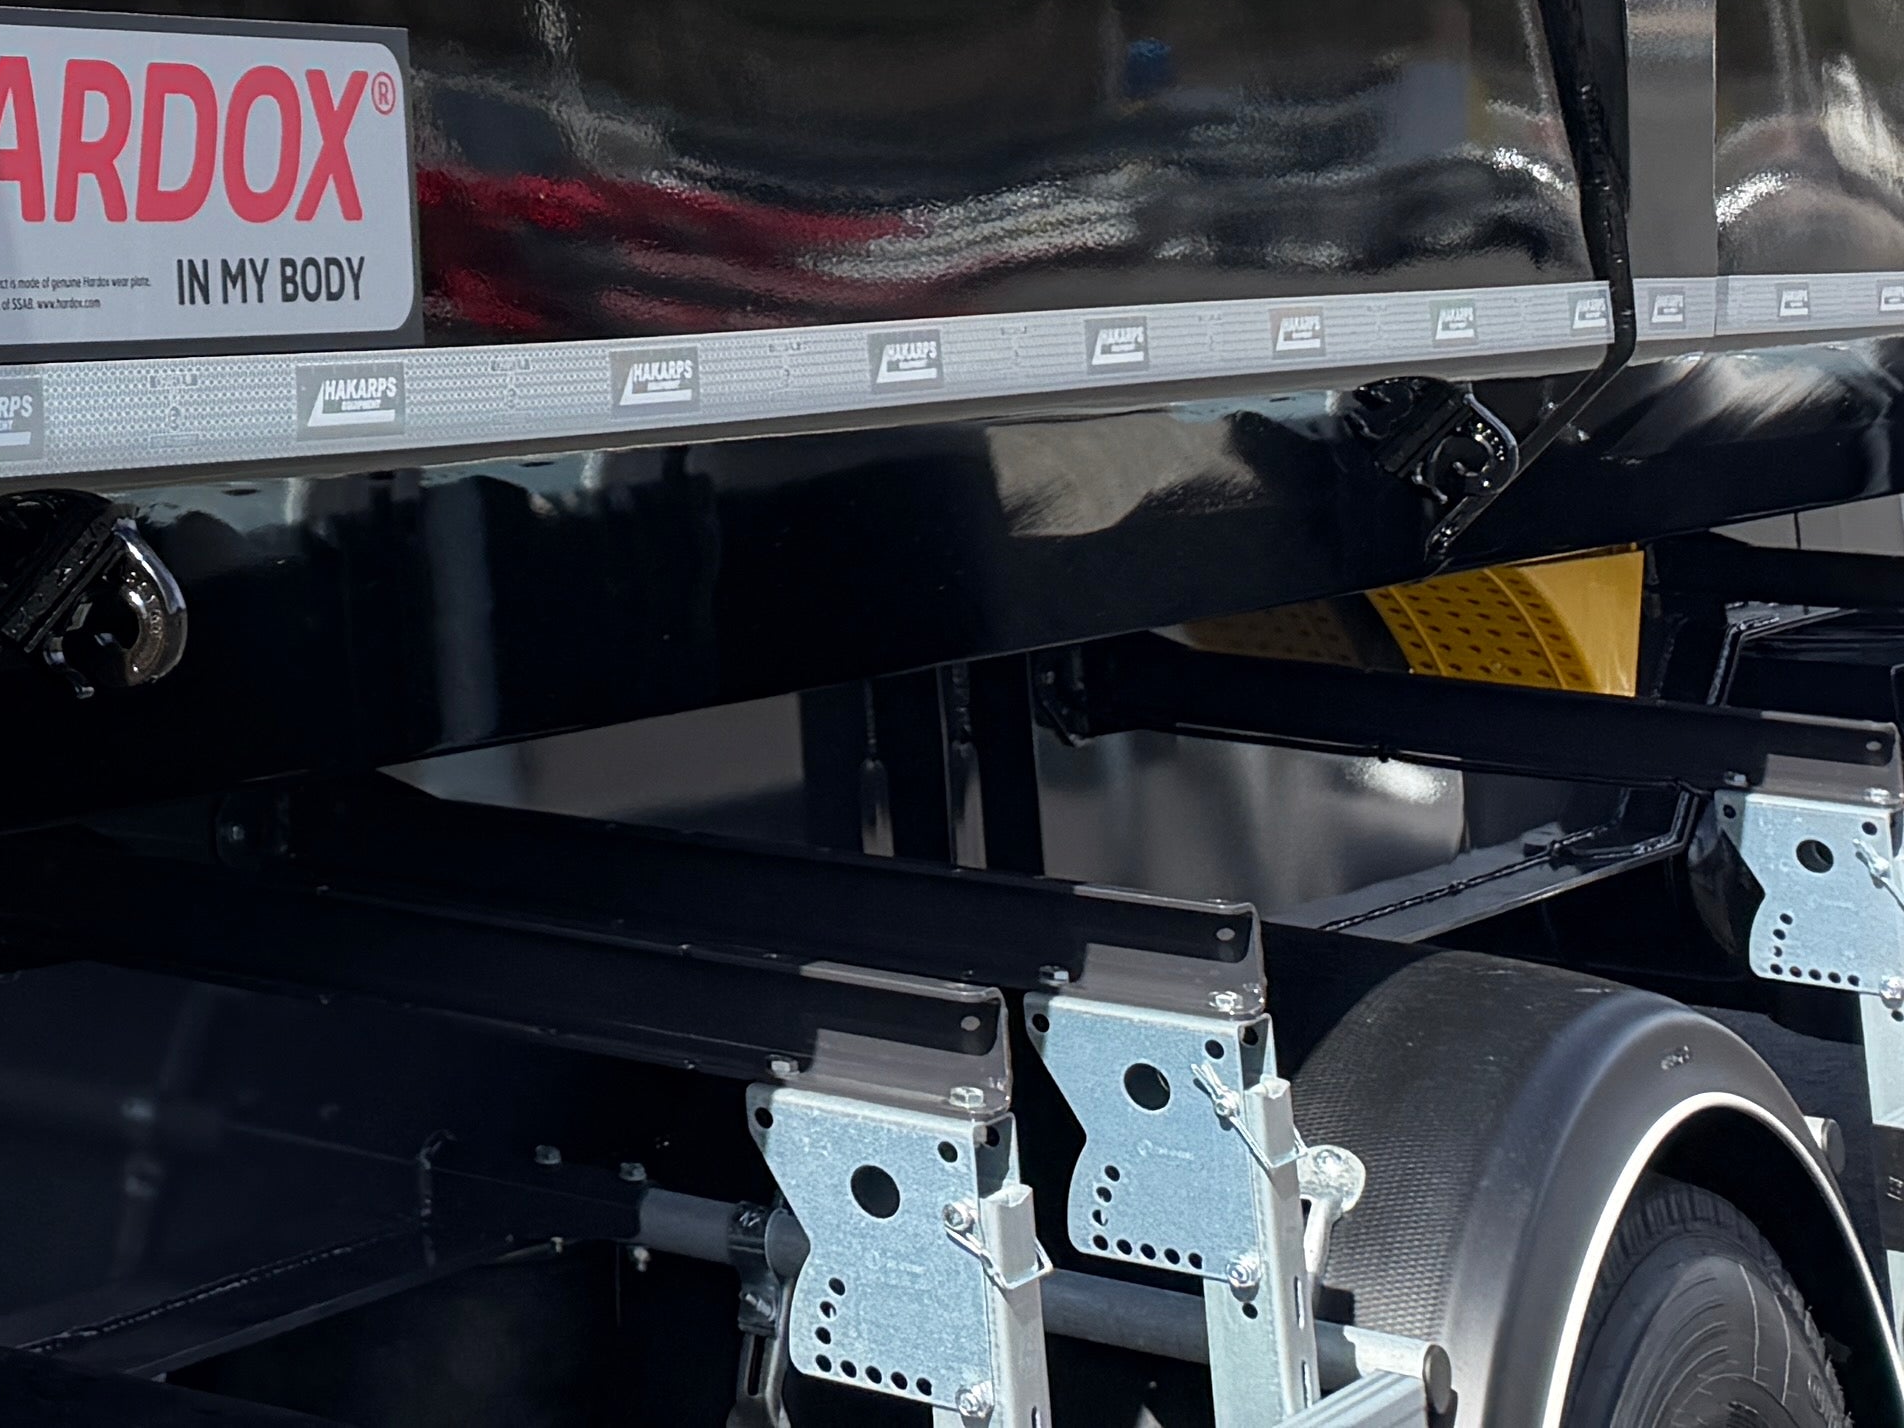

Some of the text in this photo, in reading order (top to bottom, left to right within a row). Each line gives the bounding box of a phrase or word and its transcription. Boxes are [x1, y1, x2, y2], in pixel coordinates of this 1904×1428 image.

[177, 256, 366, 306] IN MY BODY
[632, 359, 693, 383] HAKARPS
[324, 376, 398, 401] HAKARPS
